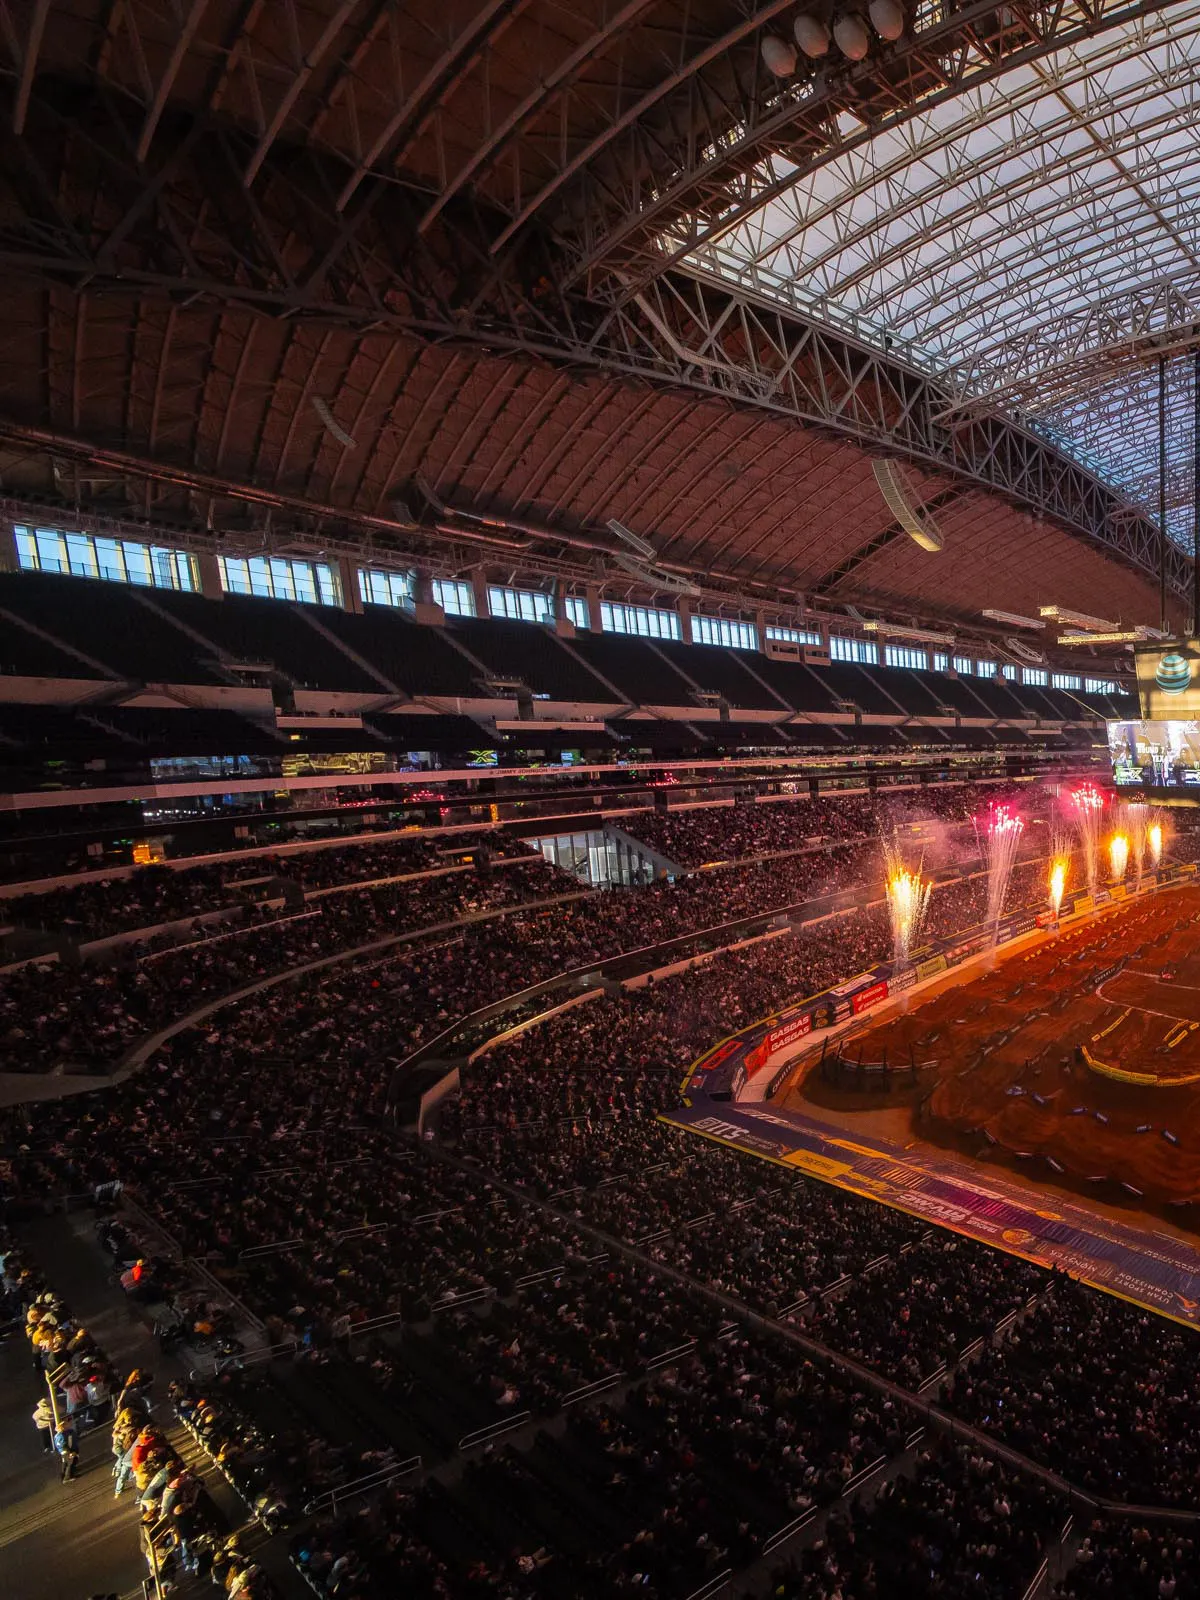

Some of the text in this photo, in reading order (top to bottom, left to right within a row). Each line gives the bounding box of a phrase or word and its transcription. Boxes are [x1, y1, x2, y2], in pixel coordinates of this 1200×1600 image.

[770, 1015, 810, 1042] GASGAS
[771, 1025, 810, 1052] GASGAS
[1049, 1249, 1098, 1273] MONSTER
[1113, 1276, 1170, 1304] UTAH SPORTS
[1118, 1272, 1174, 1299] COMMISSION
